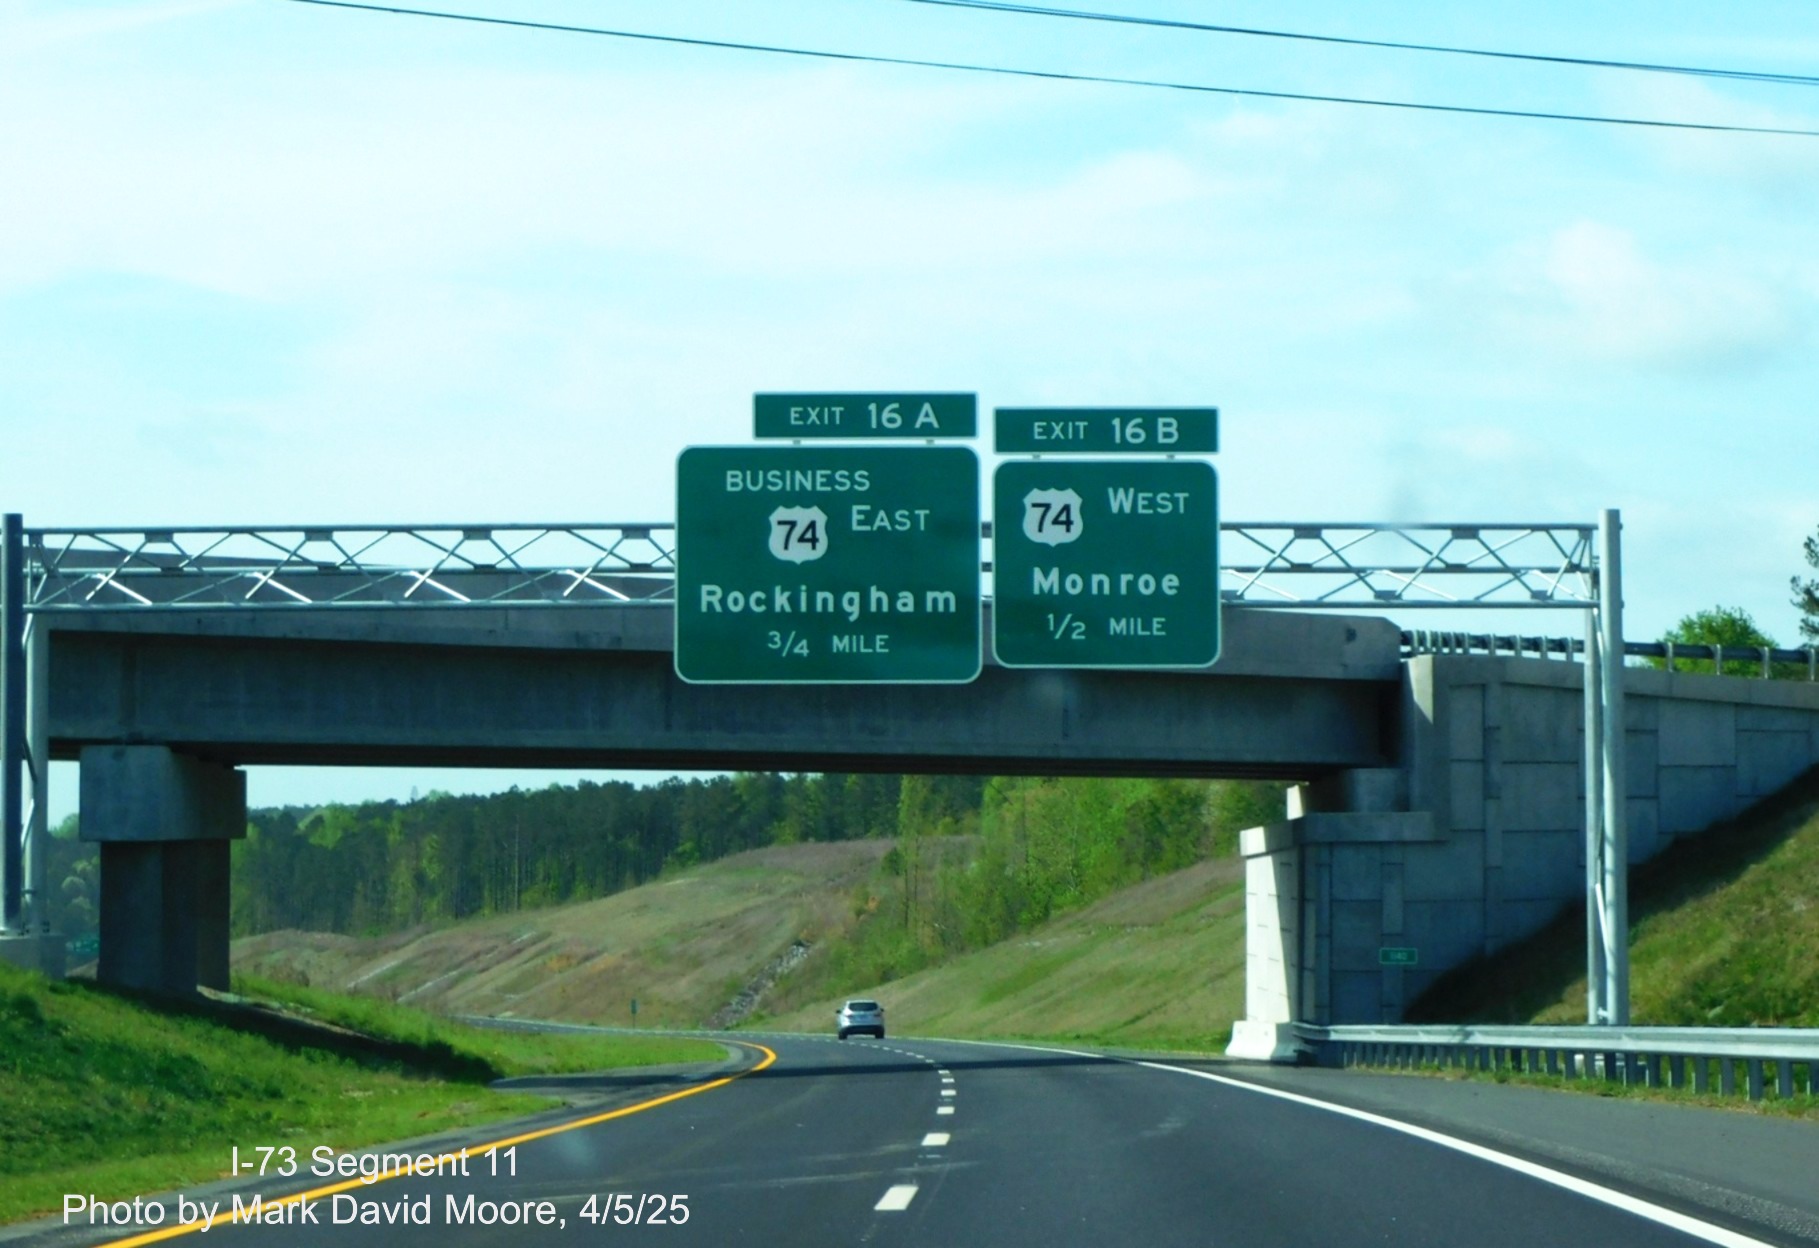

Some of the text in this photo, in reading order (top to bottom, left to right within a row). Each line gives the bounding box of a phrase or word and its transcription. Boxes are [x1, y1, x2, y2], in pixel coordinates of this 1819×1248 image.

[791, 403, 939, 428] EXIT 16 A
[1034, 418, 1178, 443] EXIT 16 B
[727, 470, 869, 491] BUSINESS
[1109, 488, 1188, 513] WEST
[852, 505, 929, 530] EAST
[1030, 502, 1075, 533] 74
[777, 520, 820, 551] 74
[1034, 567, 1179, 595] Monroe
[701, 585, 955, 621] Rockingham
[1048, 614, 1165, 639] 1/2 MILE
[768, 631, 888, 656] 3/4 MILE
